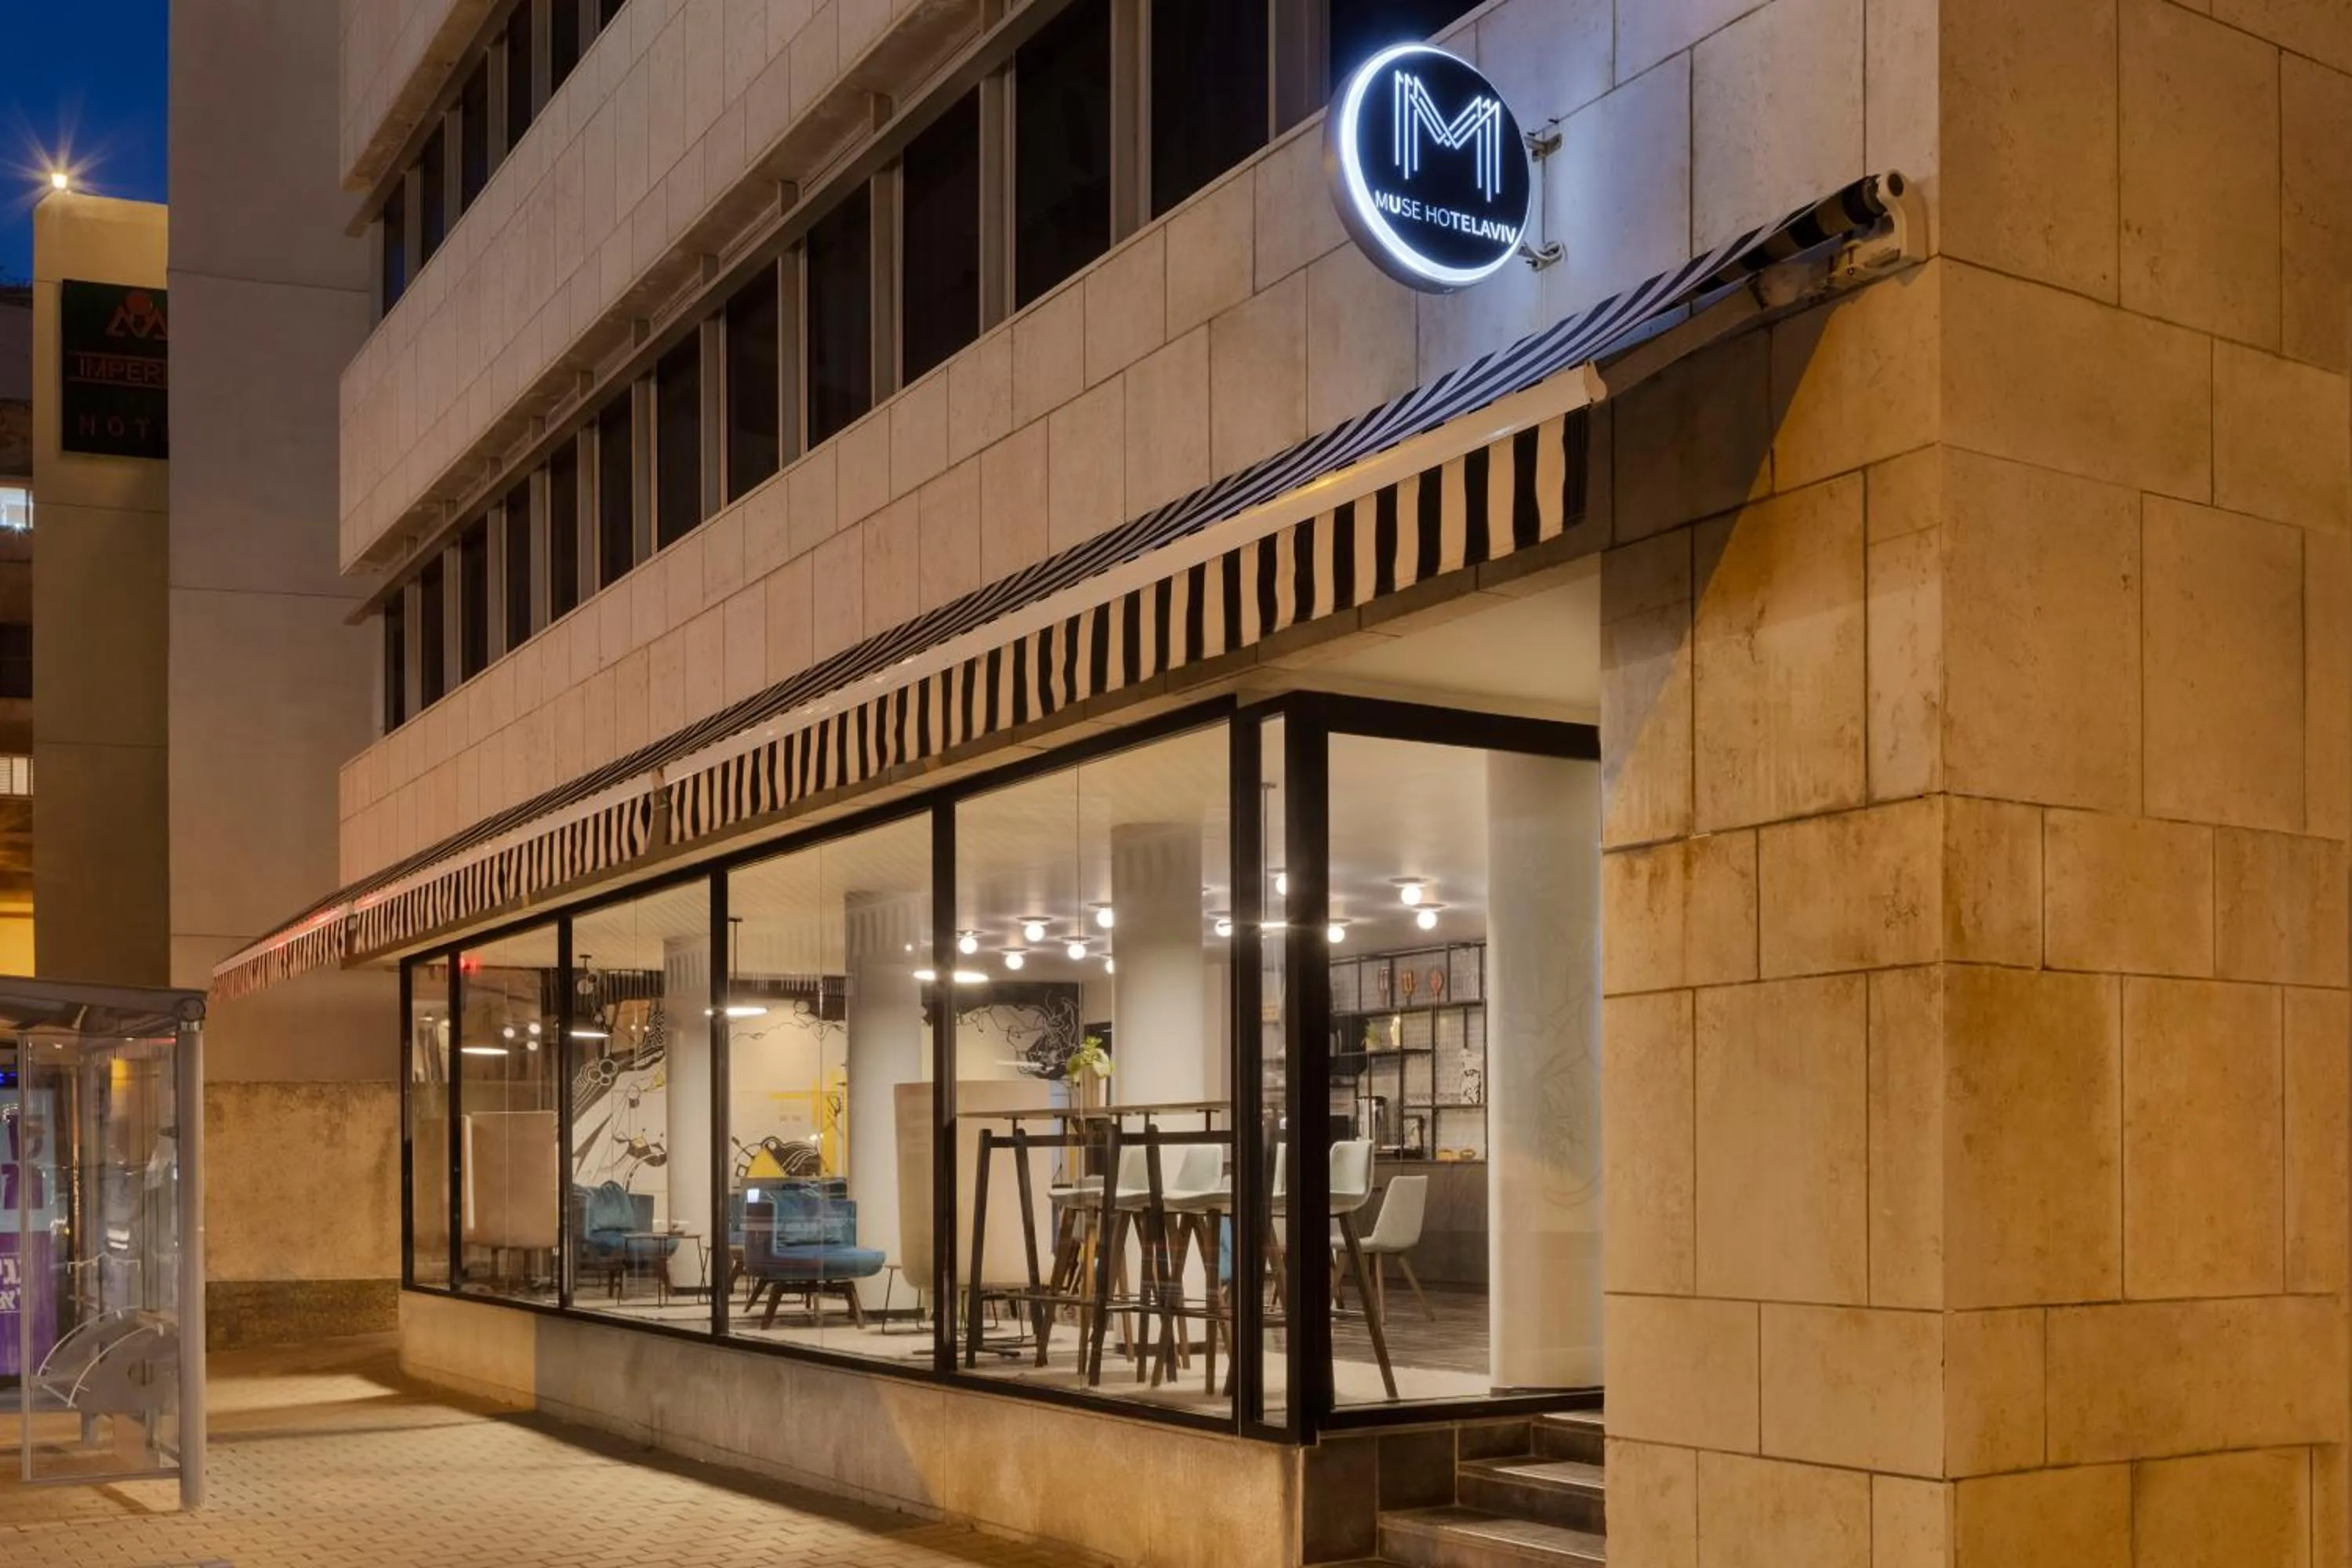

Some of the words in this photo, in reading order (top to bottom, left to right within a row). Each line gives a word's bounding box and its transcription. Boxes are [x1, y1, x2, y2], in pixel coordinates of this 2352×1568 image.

[1394, 70, 1501, 203] M
[1375, 191, 1421, 220] MUSE
[1426, 205, 1518, 245] HOTELAVIV
